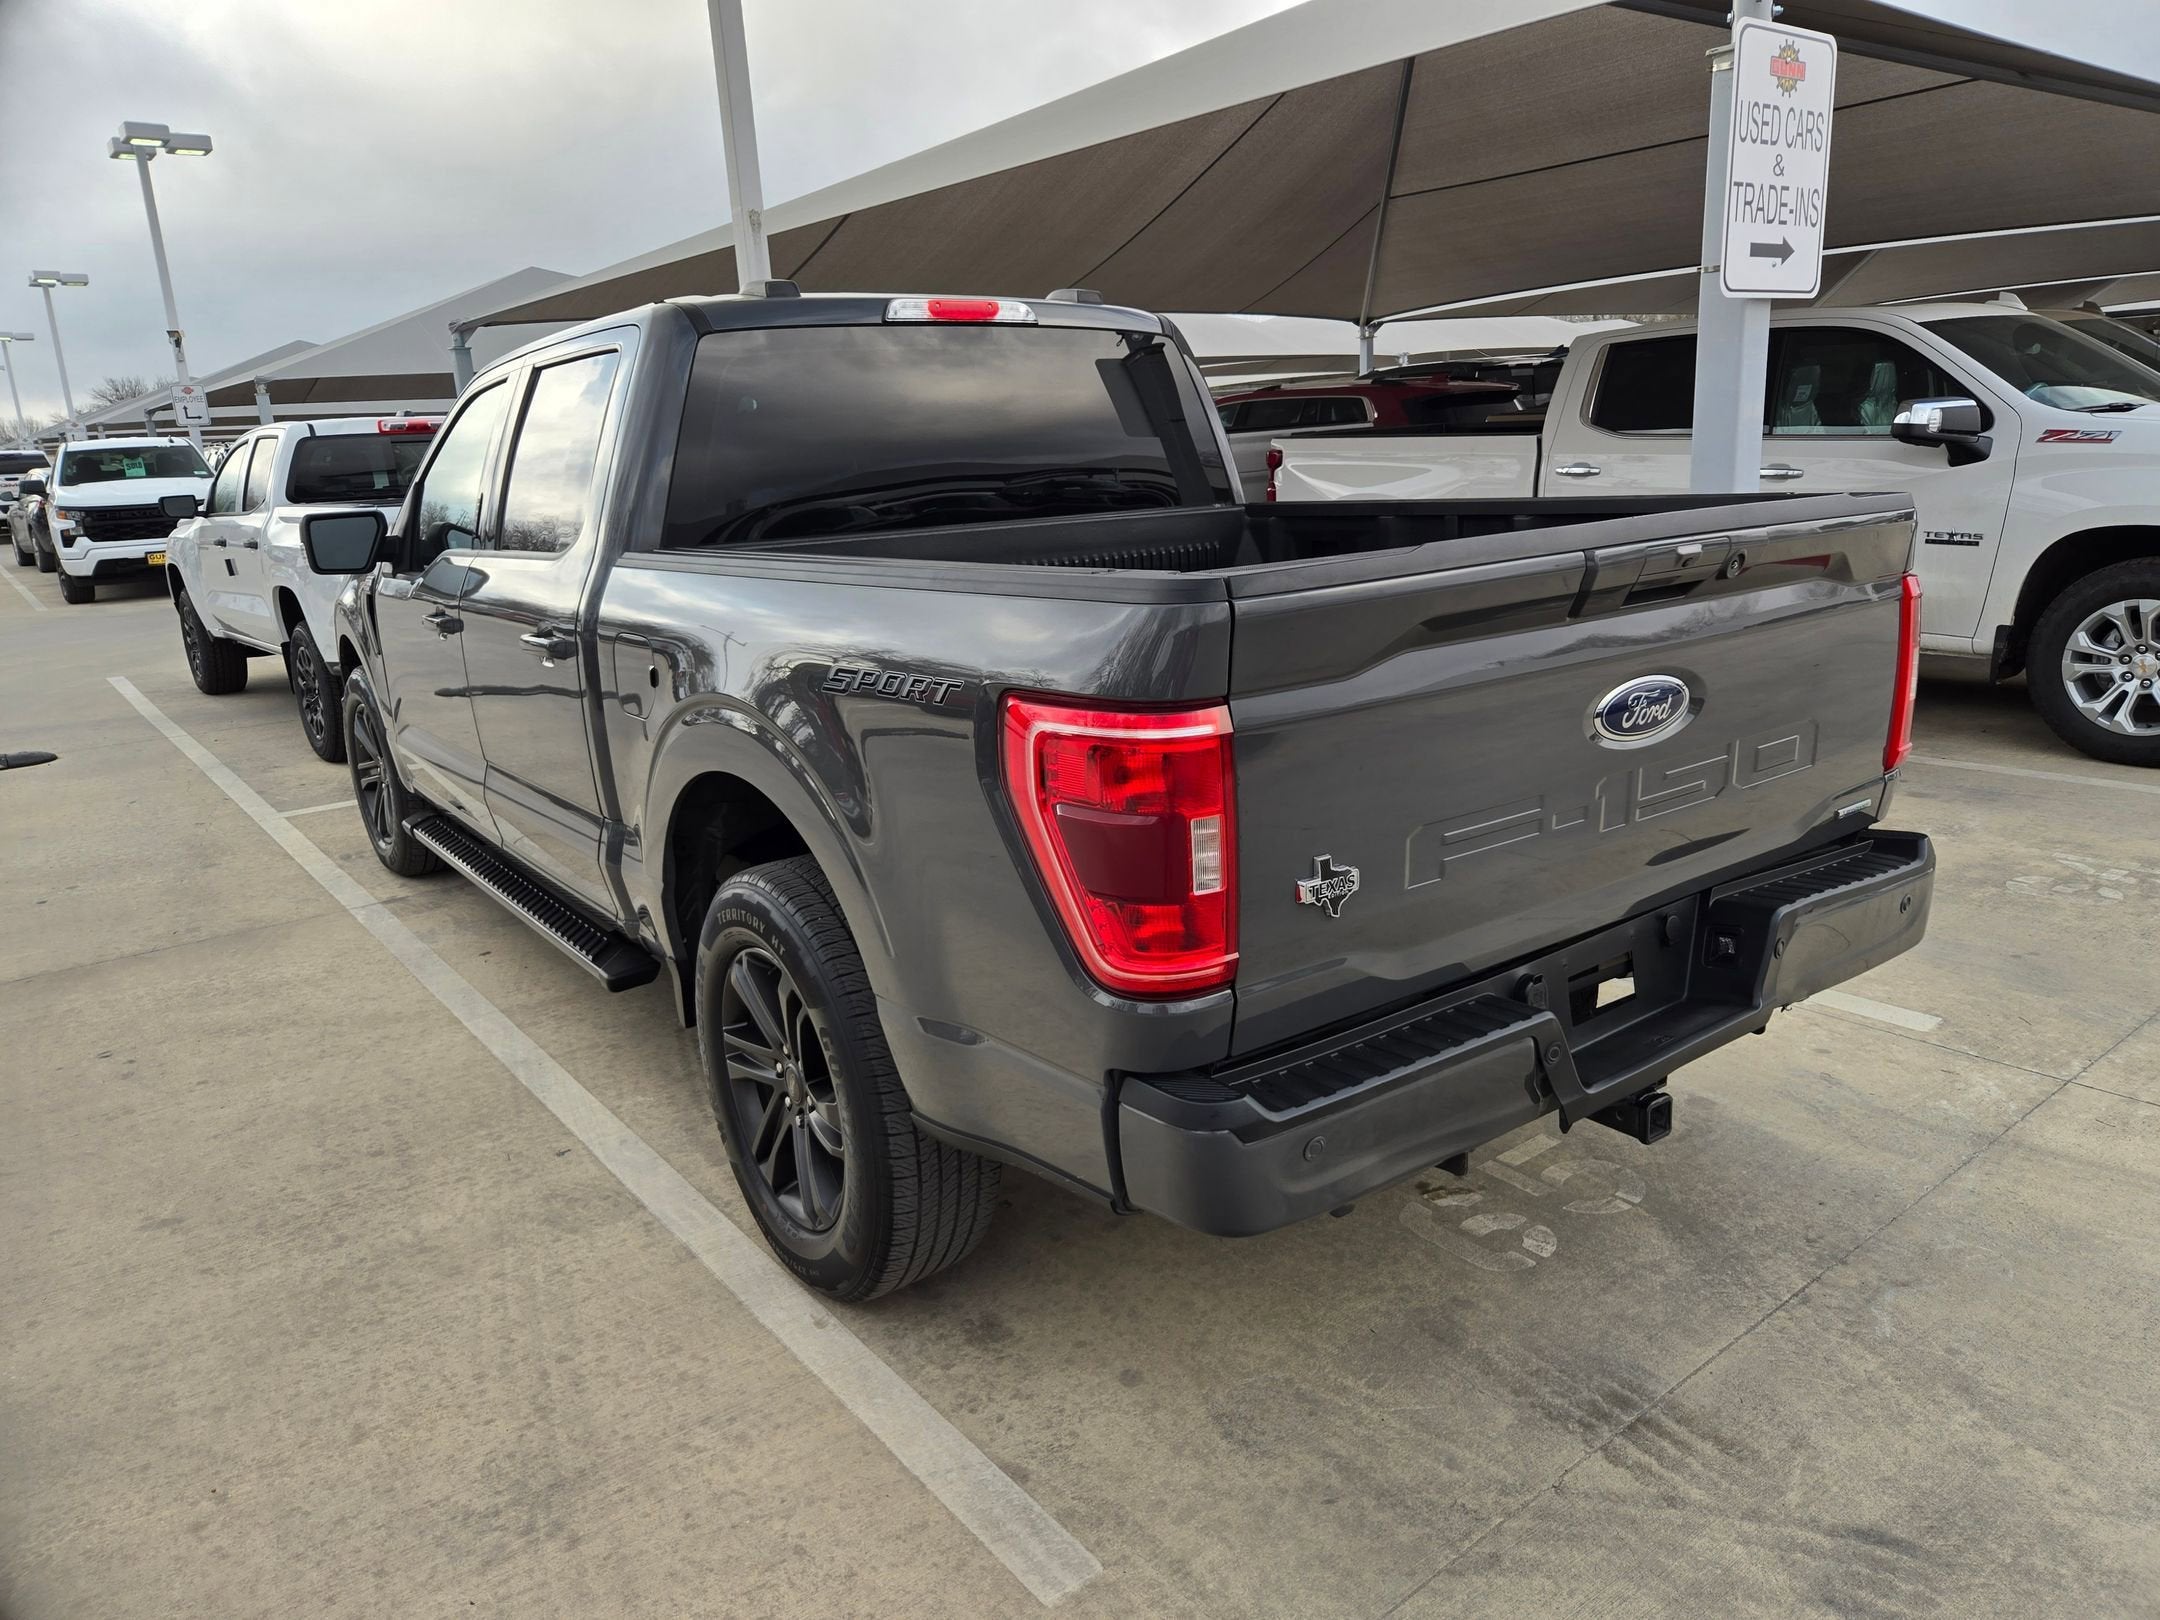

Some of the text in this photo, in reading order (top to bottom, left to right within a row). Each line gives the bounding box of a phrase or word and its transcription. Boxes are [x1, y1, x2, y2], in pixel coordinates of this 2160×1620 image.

[1771, 58, 1805, 80] GUNN
[1738, 99, 1825, 152] USED CARS
[1772, 153, 1785, 177] &
[1733, 181, 1820, 228] TRADE-INS
[174, 395, 205, 403] EMPLOYEE
[2035, 429, 2123, 443] Z71
[125, 461, 143, 470] SOLD
[1923, 528, 1984, 541] TEXAS
[821, 664, 965, 706] SPORT
[1621, 688, 1673, 729] Ford
[1404, 718, 1819, 889] F-150
[1309, 874, 1355, 899] TEXAS
[717, 908, 786, 956] TERRITORY HT
